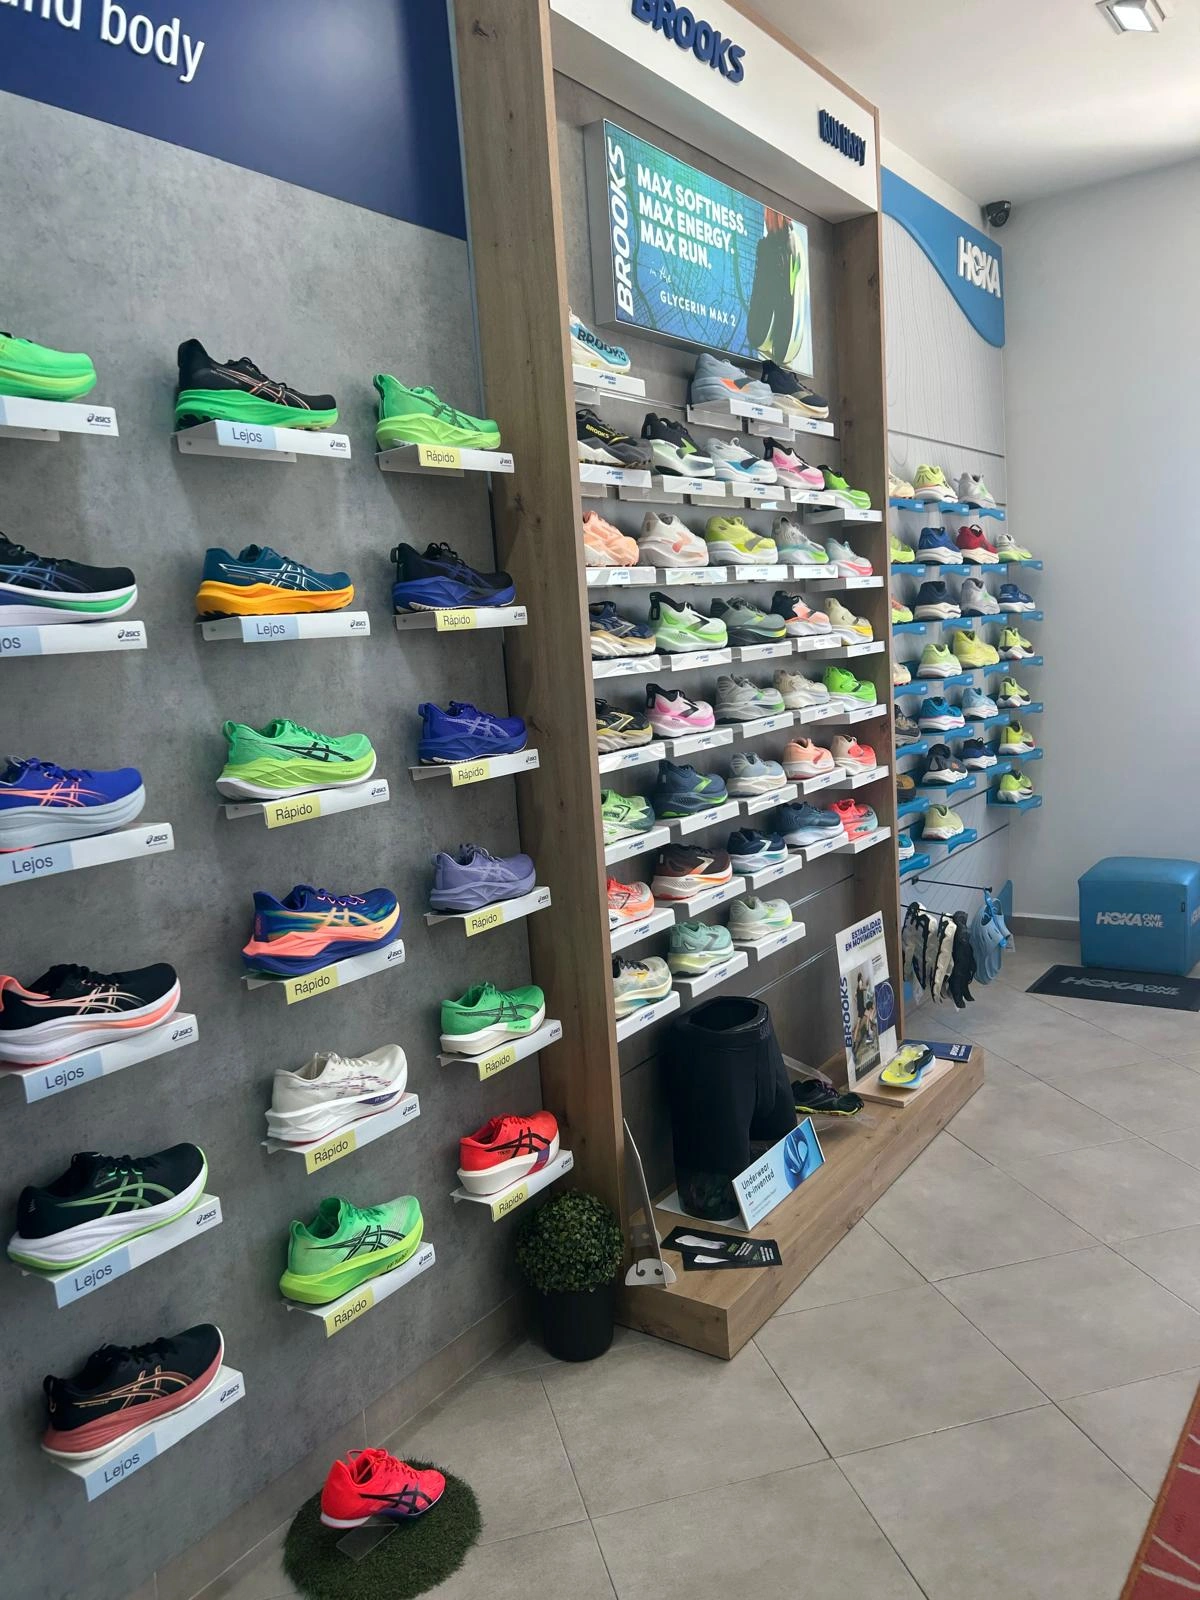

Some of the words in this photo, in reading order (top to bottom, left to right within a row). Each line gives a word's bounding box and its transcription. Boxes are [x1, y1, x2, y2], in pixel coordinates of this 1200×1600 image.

[100, 0, 205, 83] body
[637, 163, 675, 201] MAX
[675, 184, 748, 236] SOFTNESS.
[608, 137, 634, 316] BROOKS
[638, 192, 675, 226] MAX
[677, 211, 735, 254] ENERGY.
[640, 221, 677, 256] MAX
[678, 239, 712, 270] RUN.
[957, 236, 1001, 298] HOKA
[660, 290, 707, 314] GLYCERIN
[709, 307, 728, 325] MAX
[730, 315, 737, 328] 2
[577, 329, 627, 361] BROOKS
[232, 427, 263, 443] Lejos
[585, 423, 610, 439] BROOKS
[425, 450, 454, 464] Rápido
[256, 623, 286, 637] Lejos
[442, 615, 469, 628] Rápido
[457, 767, 484, 780] Rápido
[275, 804, 313, 821] Rápido
[11, 856, 53, 874] Lejos
[471, 914, 497, 930] Rápido
[852, 918, 881, 940] ESTABILIDAD
[1096, 912, 1143, 927] HOKA
[1143, 920, 1164, 928] ONE
[845, 943, 852, 952] EN
[851, 926, 882, 949] MOVIMIENTO
[293, 975, 328, 995] Rápido
[1060, 976, 1144, 992] HOKA
[840, 977, 853, 1048] BROOKS
[485, 1054, 510, 1073] Rápido
[45, 1067, 84, 1090] Lejos
[314, 1140, 348, 1164] Rápido
[741, 1162, 769, 1190] Underwear
[745, 1169, 775, 1200] re-invented
[499, 1191, 524, 1213] Rápido
[75, 1264, 112, 1291] Lejos
[333, 1298, 367, 1327] Rápido
[104, 1453, 140, 1483] Lejos
